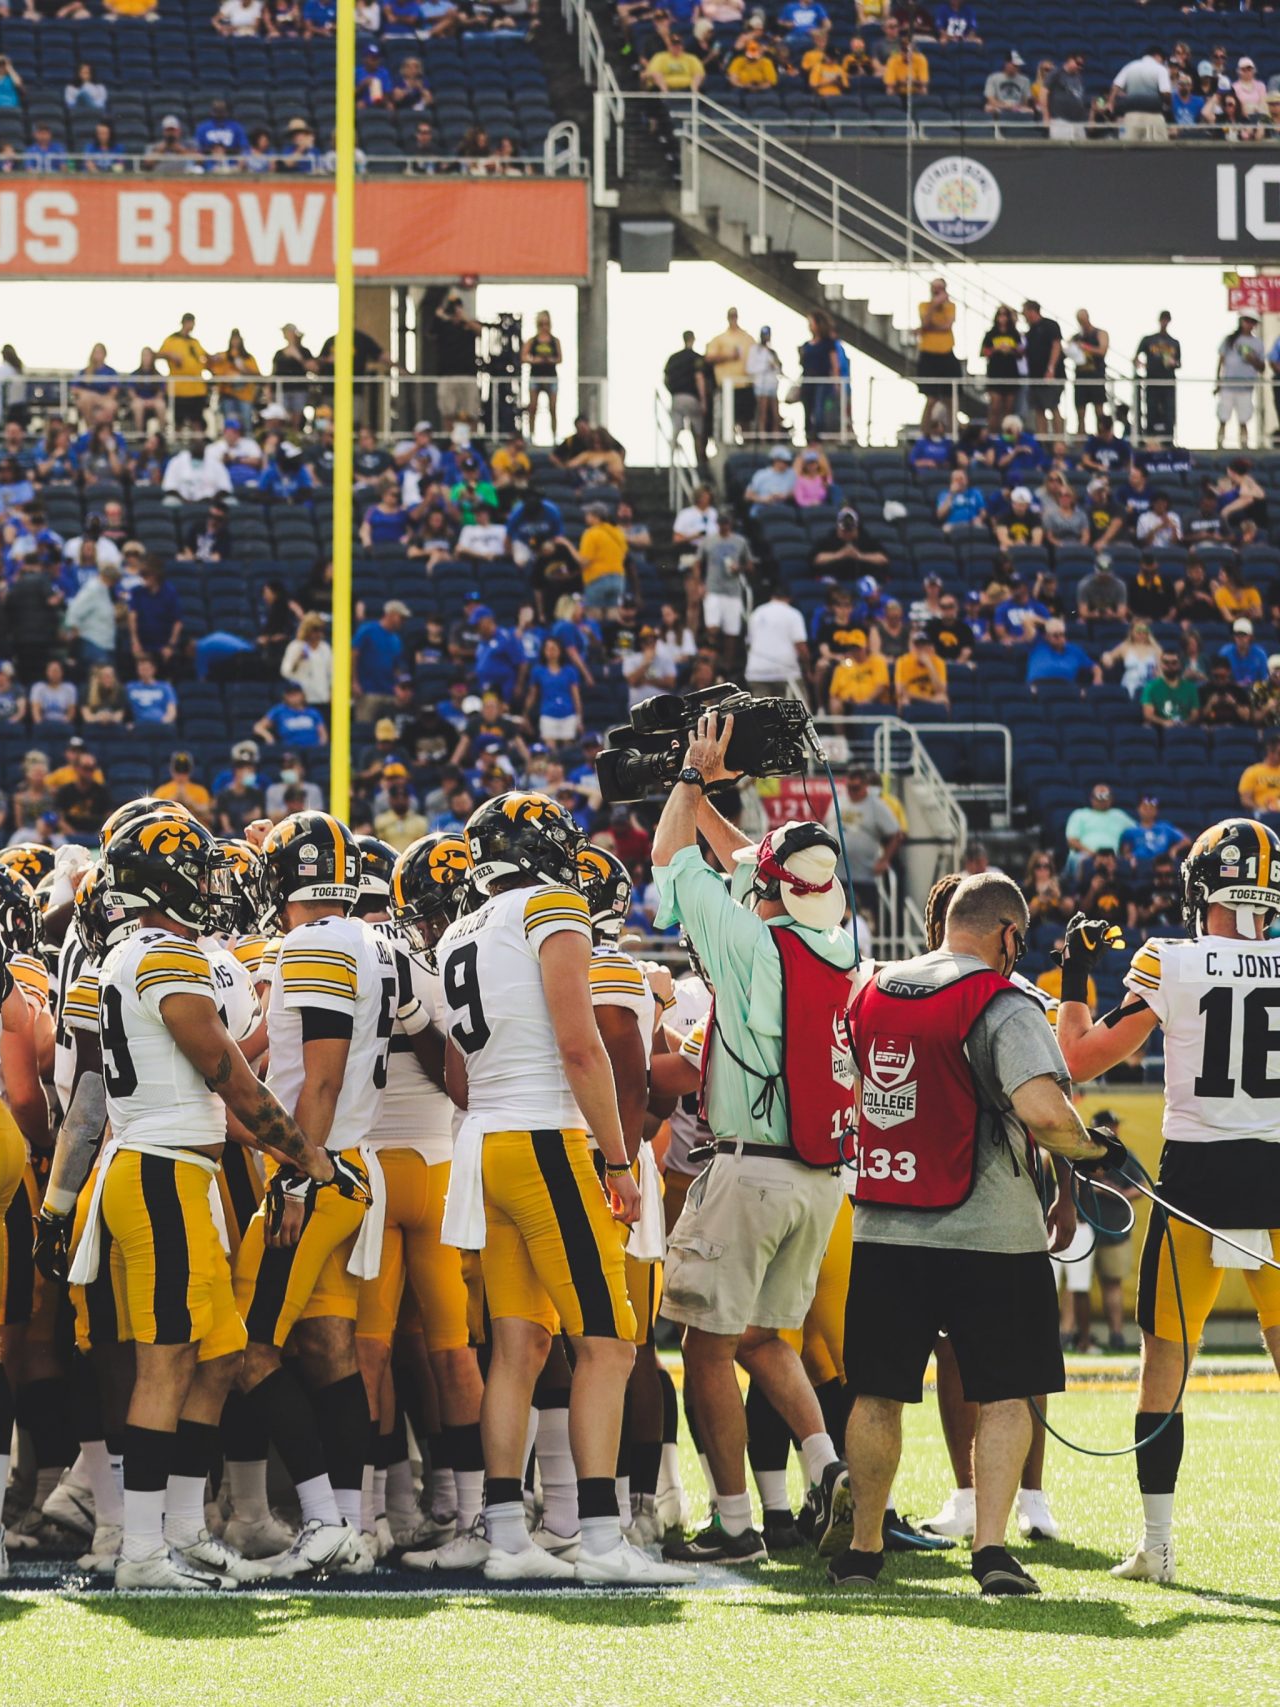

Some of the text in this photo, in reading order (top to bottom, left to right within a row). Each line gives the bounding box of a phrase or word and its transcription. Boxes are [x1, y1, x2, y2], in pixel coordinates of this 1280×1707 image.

[469, 838, 482, 859] 9
[345, 855, 356, 878] 5
[1206, 952, 1223, 977] C.
[444, 941, 492, 1055] 9
[99, 983, 139, 1099] 9
[875, 1051, 906, 1065] ESPN
[863, 1092, 915, 1111] COLLEGE
[867, 1107, 905, 1118] FOOTBALL
